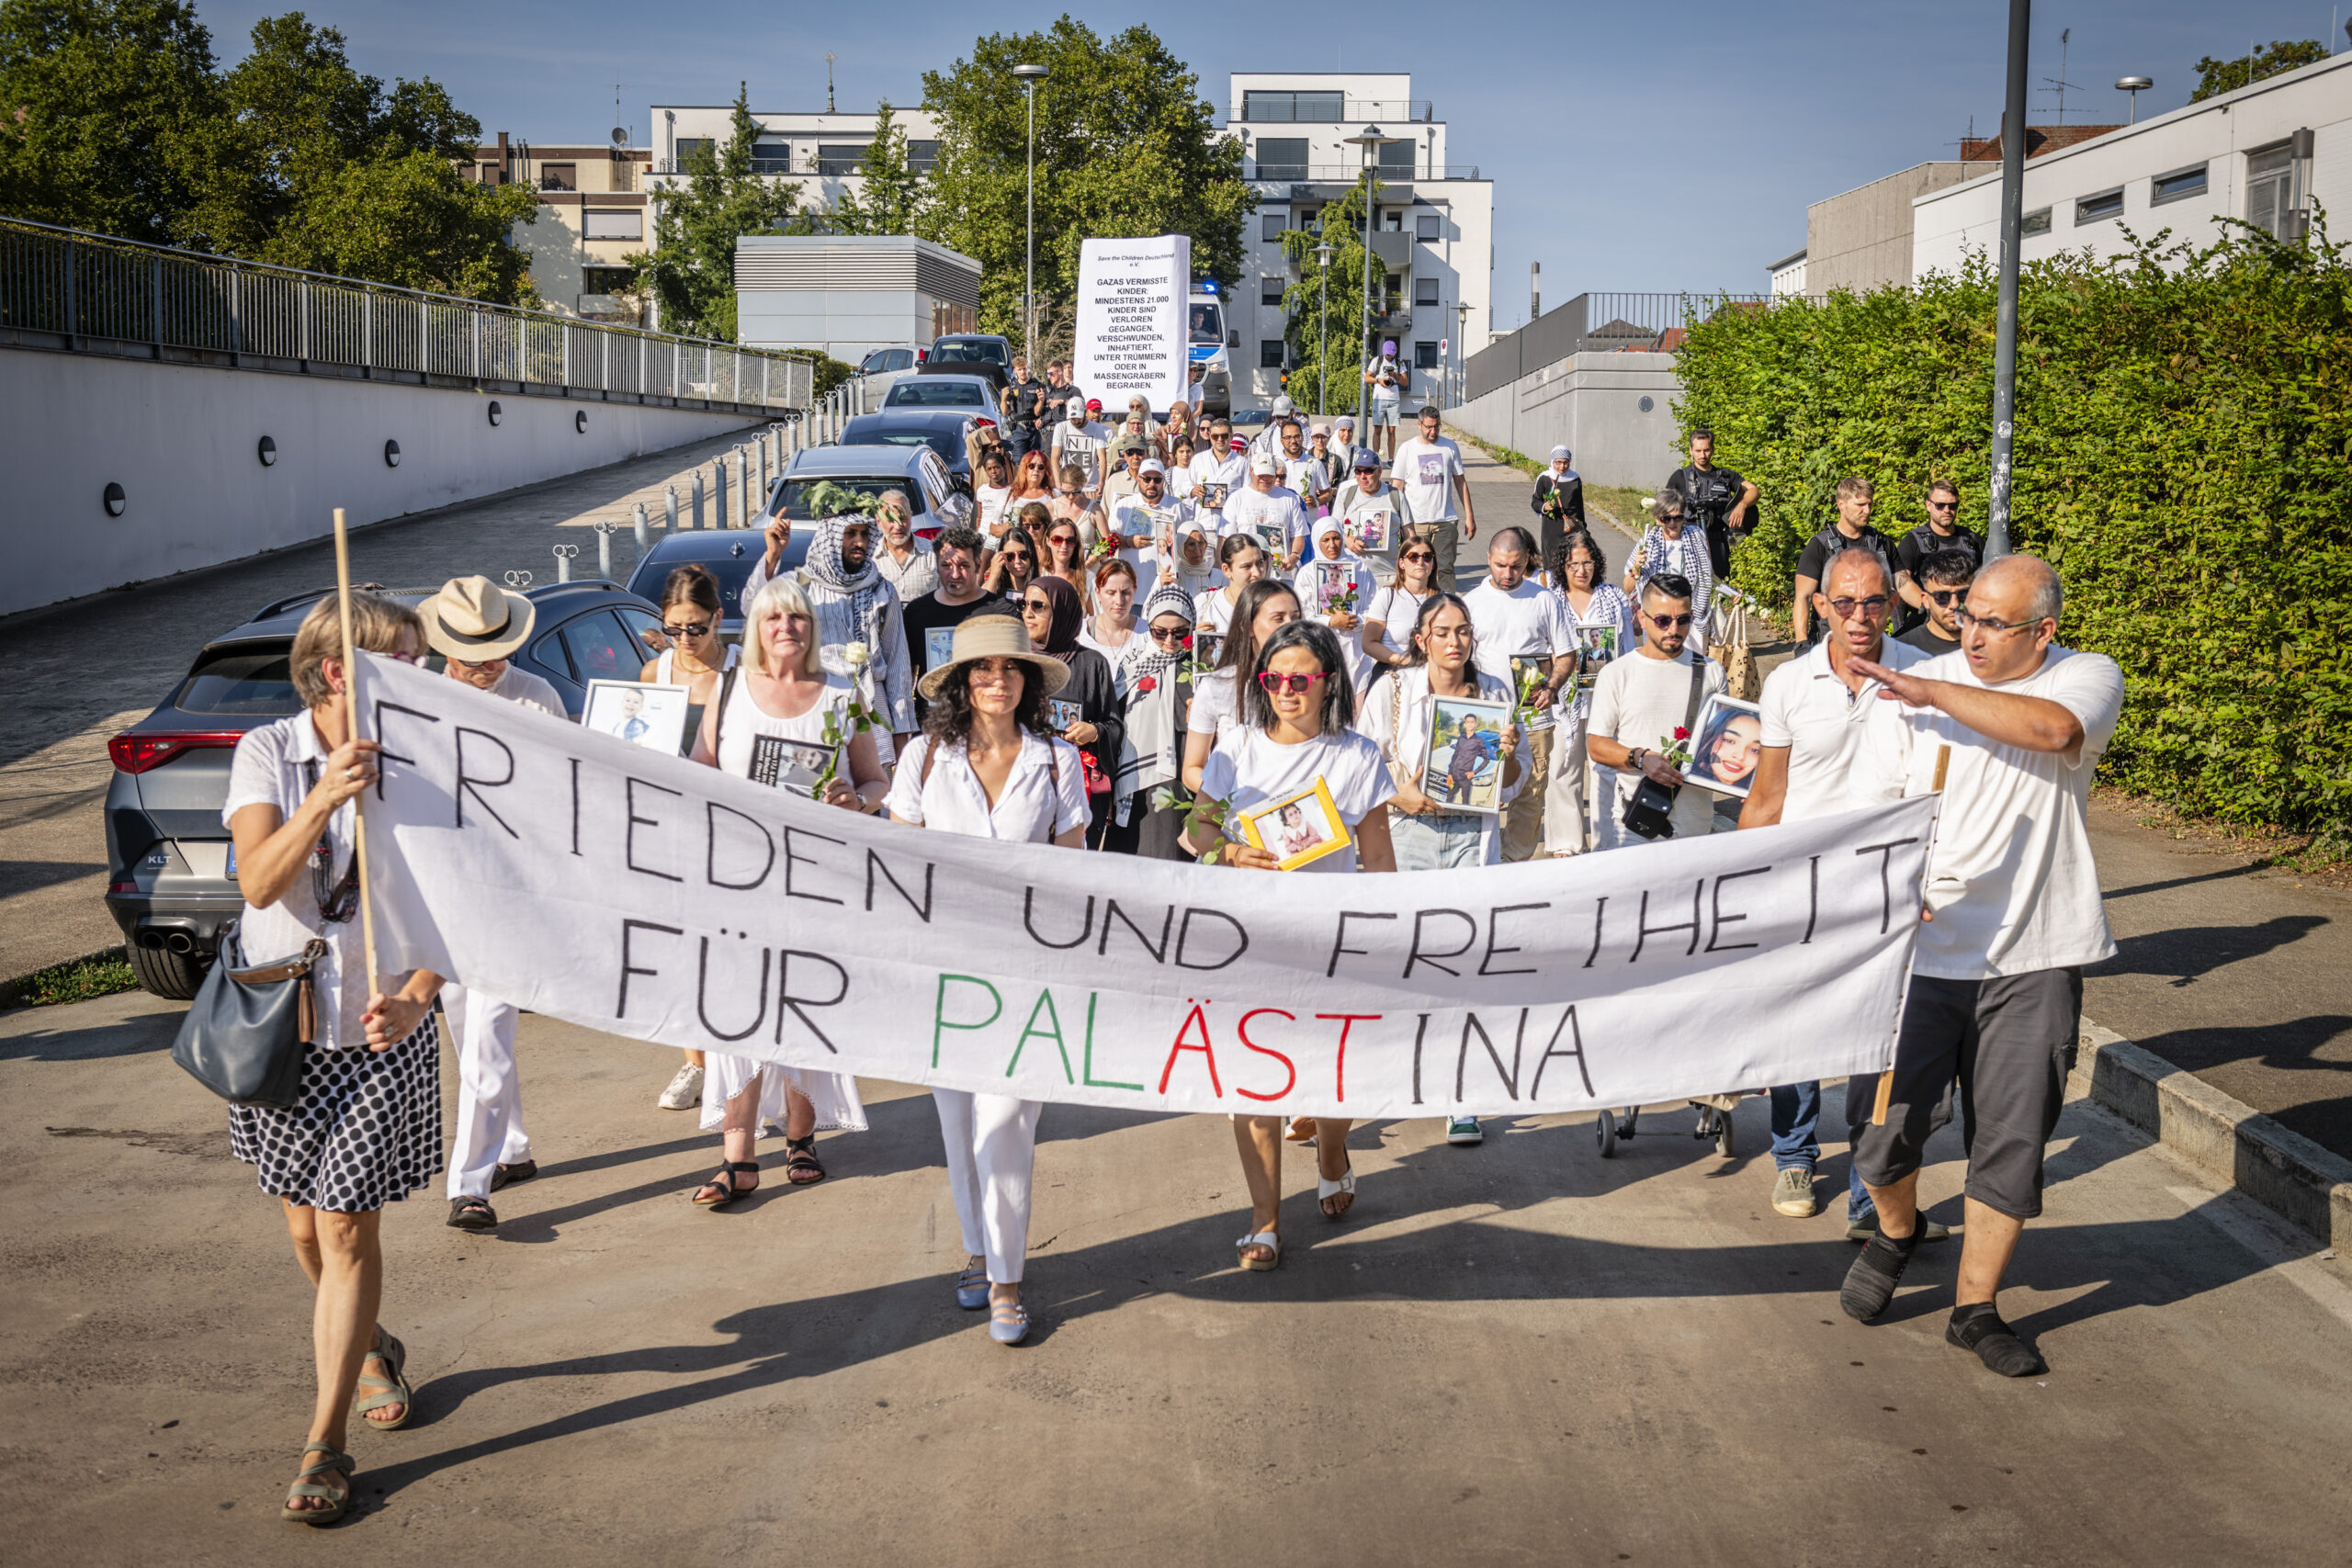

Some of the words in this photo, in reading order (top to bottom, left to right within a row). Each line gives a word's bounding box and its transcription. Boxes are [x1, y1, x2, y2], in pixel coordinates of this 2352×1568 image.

[1145, 253, 1175, 261] Deutschland
[1125, 276, 1169, 286] VERMISSTE
[1094, 297, 1146, 305] MINDESTENS
[1147, 296, 1170, 304] 21.000
[1107, 306, 1136, 314] KINDER
[1111, 315, 1153, 323] VERLOREN
[1097, 333, 1165, 343] VERSCHWUNDEN,
[1123, 353, 1167, 361] TRÜMMERN
[1093, 371, 1166, 380] MASSENGRÄBERN
[1106, 381, 1153, 389] BEGRABEN.
[375, 699, 935, 923] FRIEDEN
[1023, 886, 1250, 970] UND
[1327, 837, 1919, 979] FREIHEIT
[147, 855, 173, 864] KLT
[616, 919, 850, 1055] FÜR
[931, 973, 1595, 1105] PALÄSTINA
